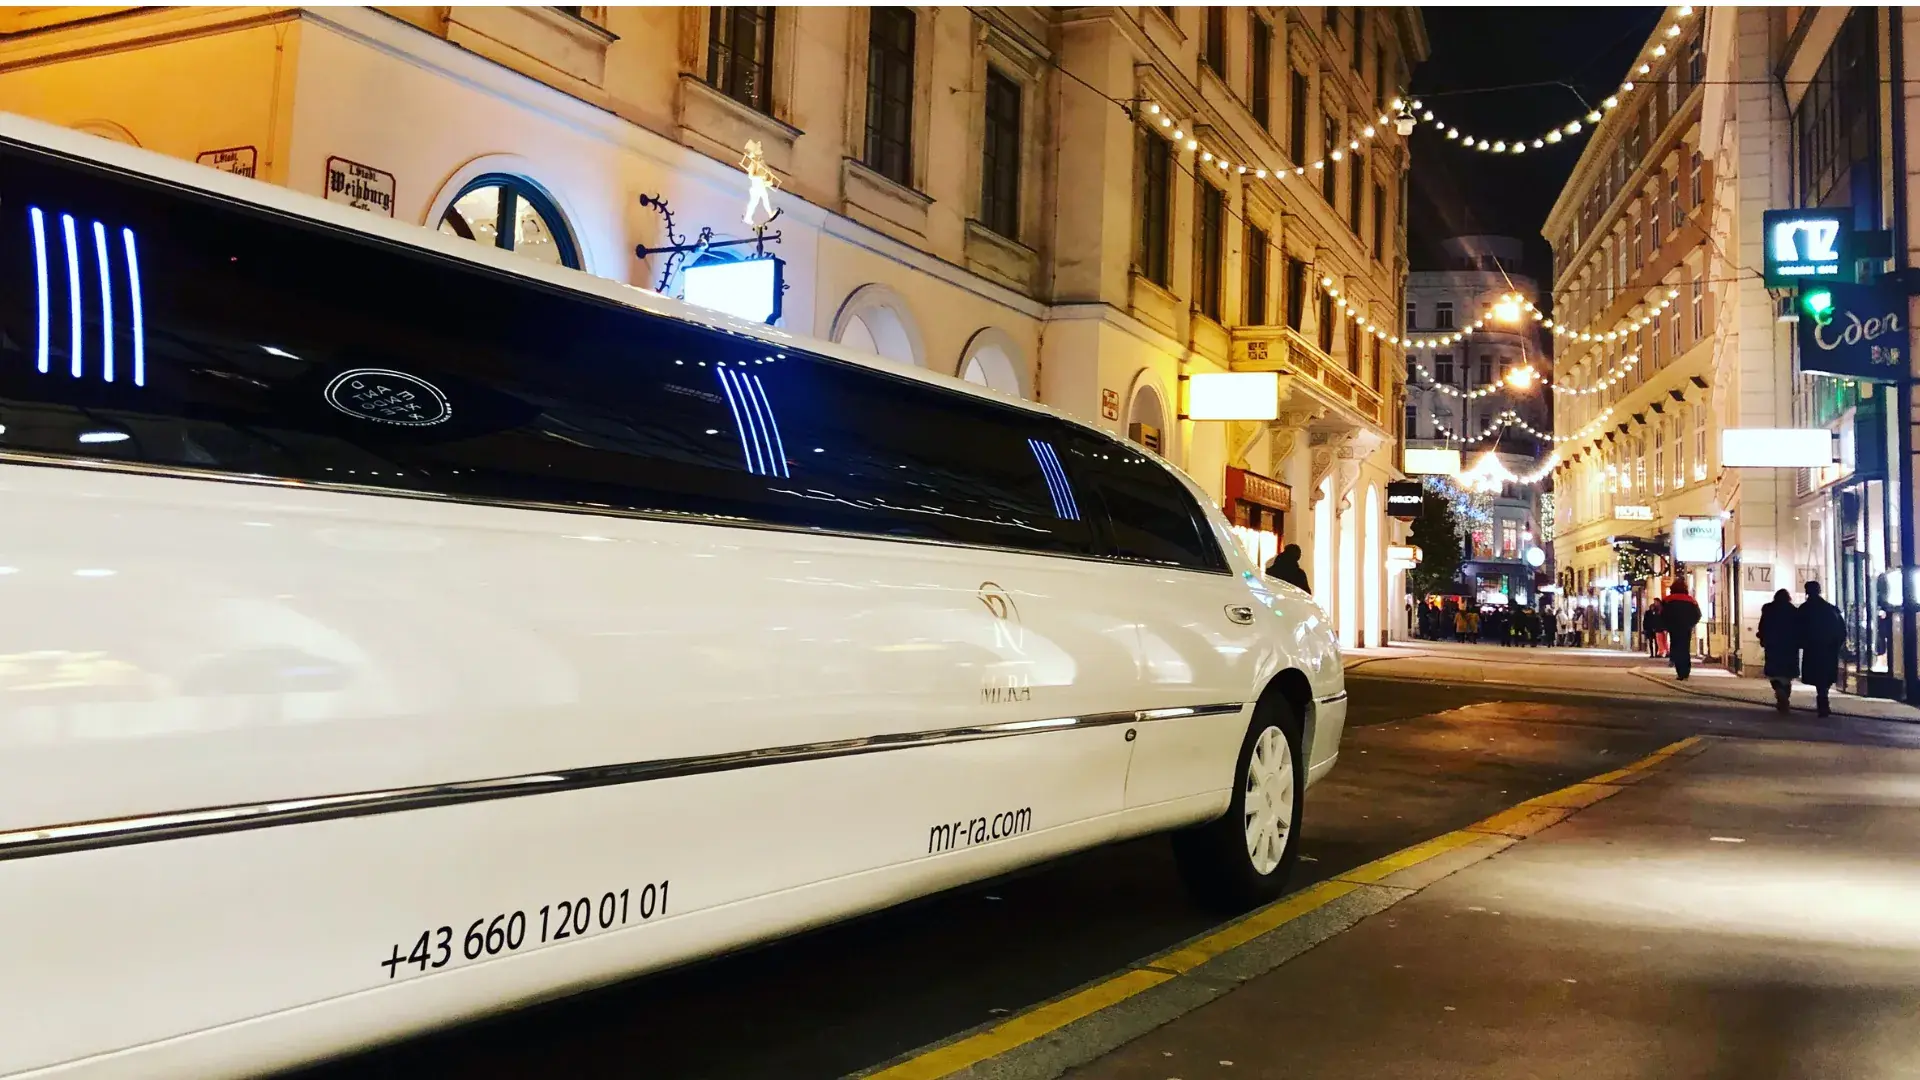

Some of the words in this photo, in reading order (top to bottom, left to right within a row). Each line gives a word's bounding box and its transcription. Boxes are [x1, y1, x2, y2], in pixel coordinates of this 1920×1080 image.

[1814, 306, 1904, 350] Eden
[928, 806, 1032, 854] mr-ra.com
[381, 926, 453, 979] +43
[463, 910, 526, 960] 660
[539, 897, 591, 943] 120
[599, 888, 630, 929] 01
[640, 880, 670, 919] 01
